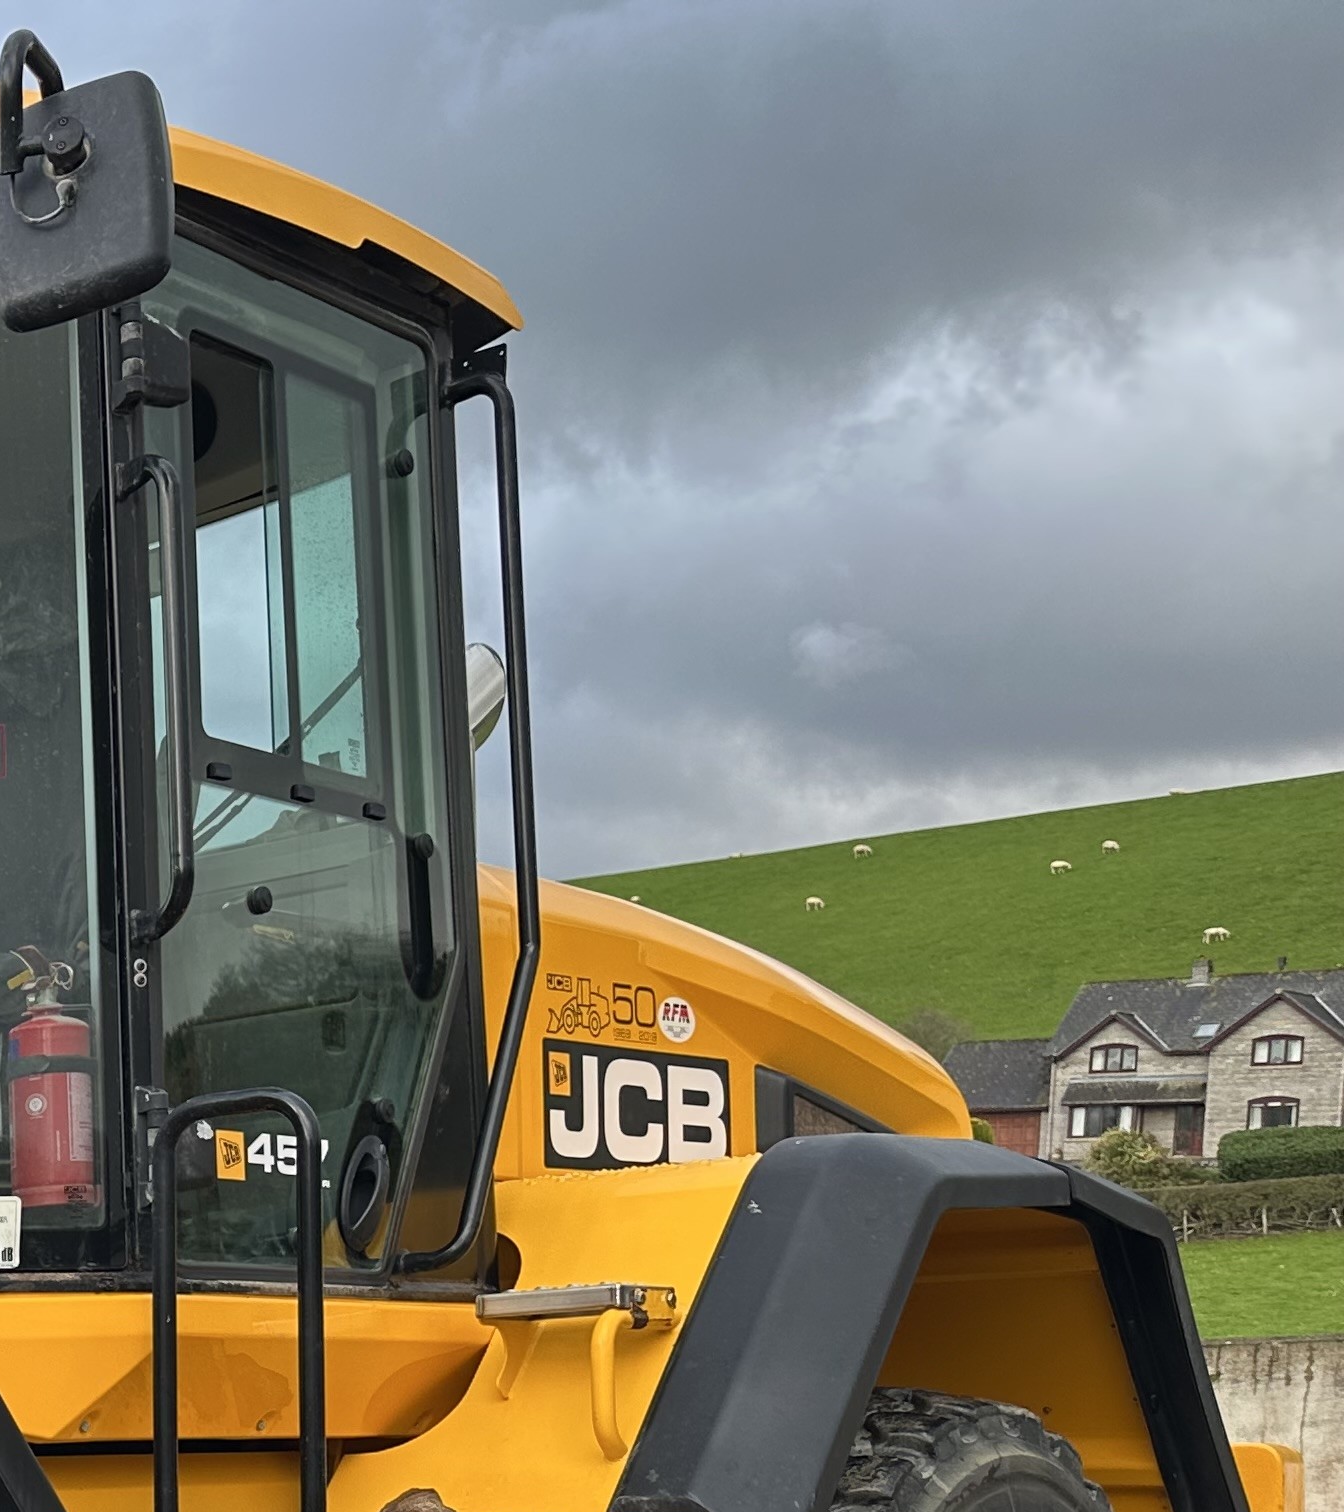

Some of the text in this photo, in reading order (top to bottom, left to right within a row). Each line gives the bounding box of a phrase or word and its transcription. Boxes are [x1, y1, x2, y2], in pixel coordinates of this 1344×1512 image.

[547, 973, 572, 992] JCB
[612, 982, 656, 1028] 50
[549, 1055, 727, 1164] JCB
[222, 1141, 242, 1166] JCB
